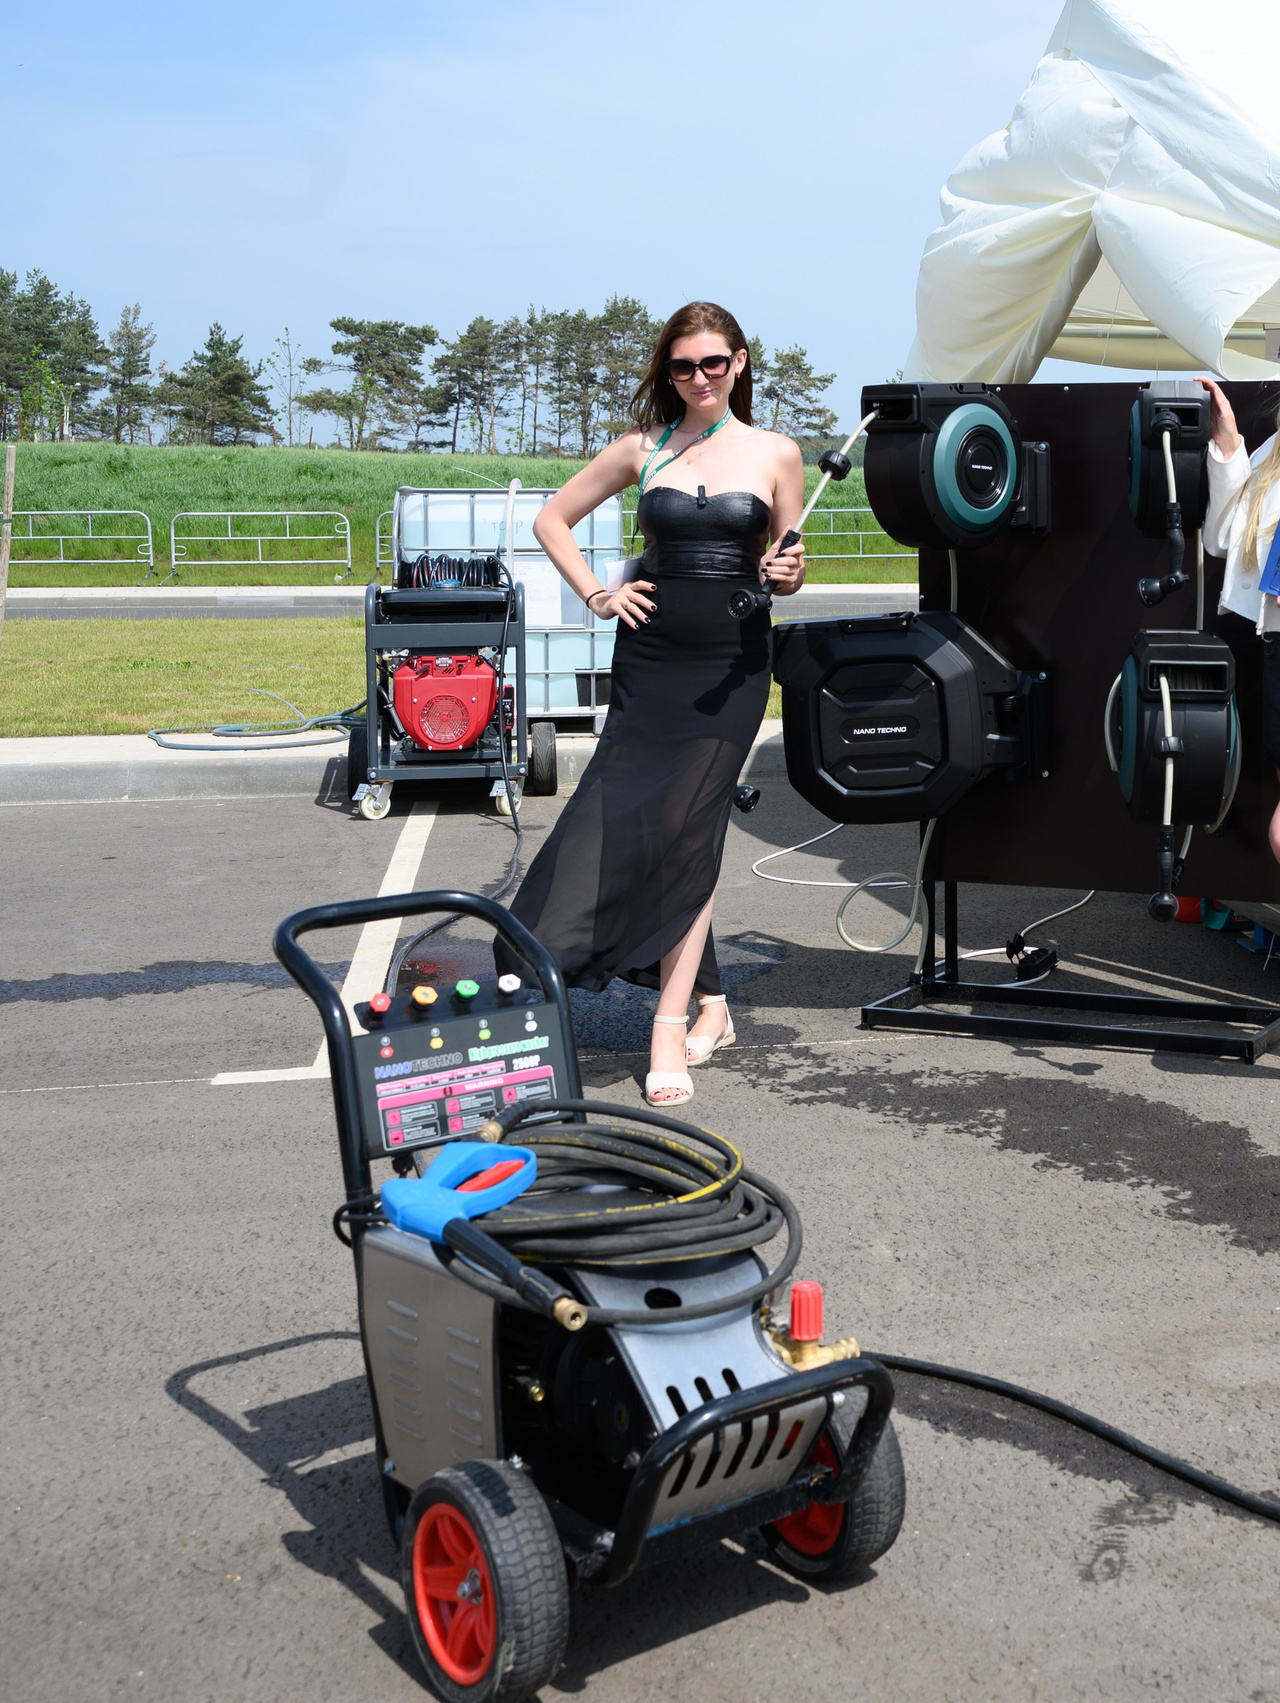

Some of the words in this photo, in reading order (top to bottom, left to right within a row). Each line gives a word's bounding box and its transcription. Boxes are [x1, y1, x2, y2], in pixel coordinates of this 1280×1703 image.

[877, 726, 907, 734] TECHNO
[374, 1052, 463, 1079] NANOTECHNO
[463, 1077, 505, 1091] WARNING
